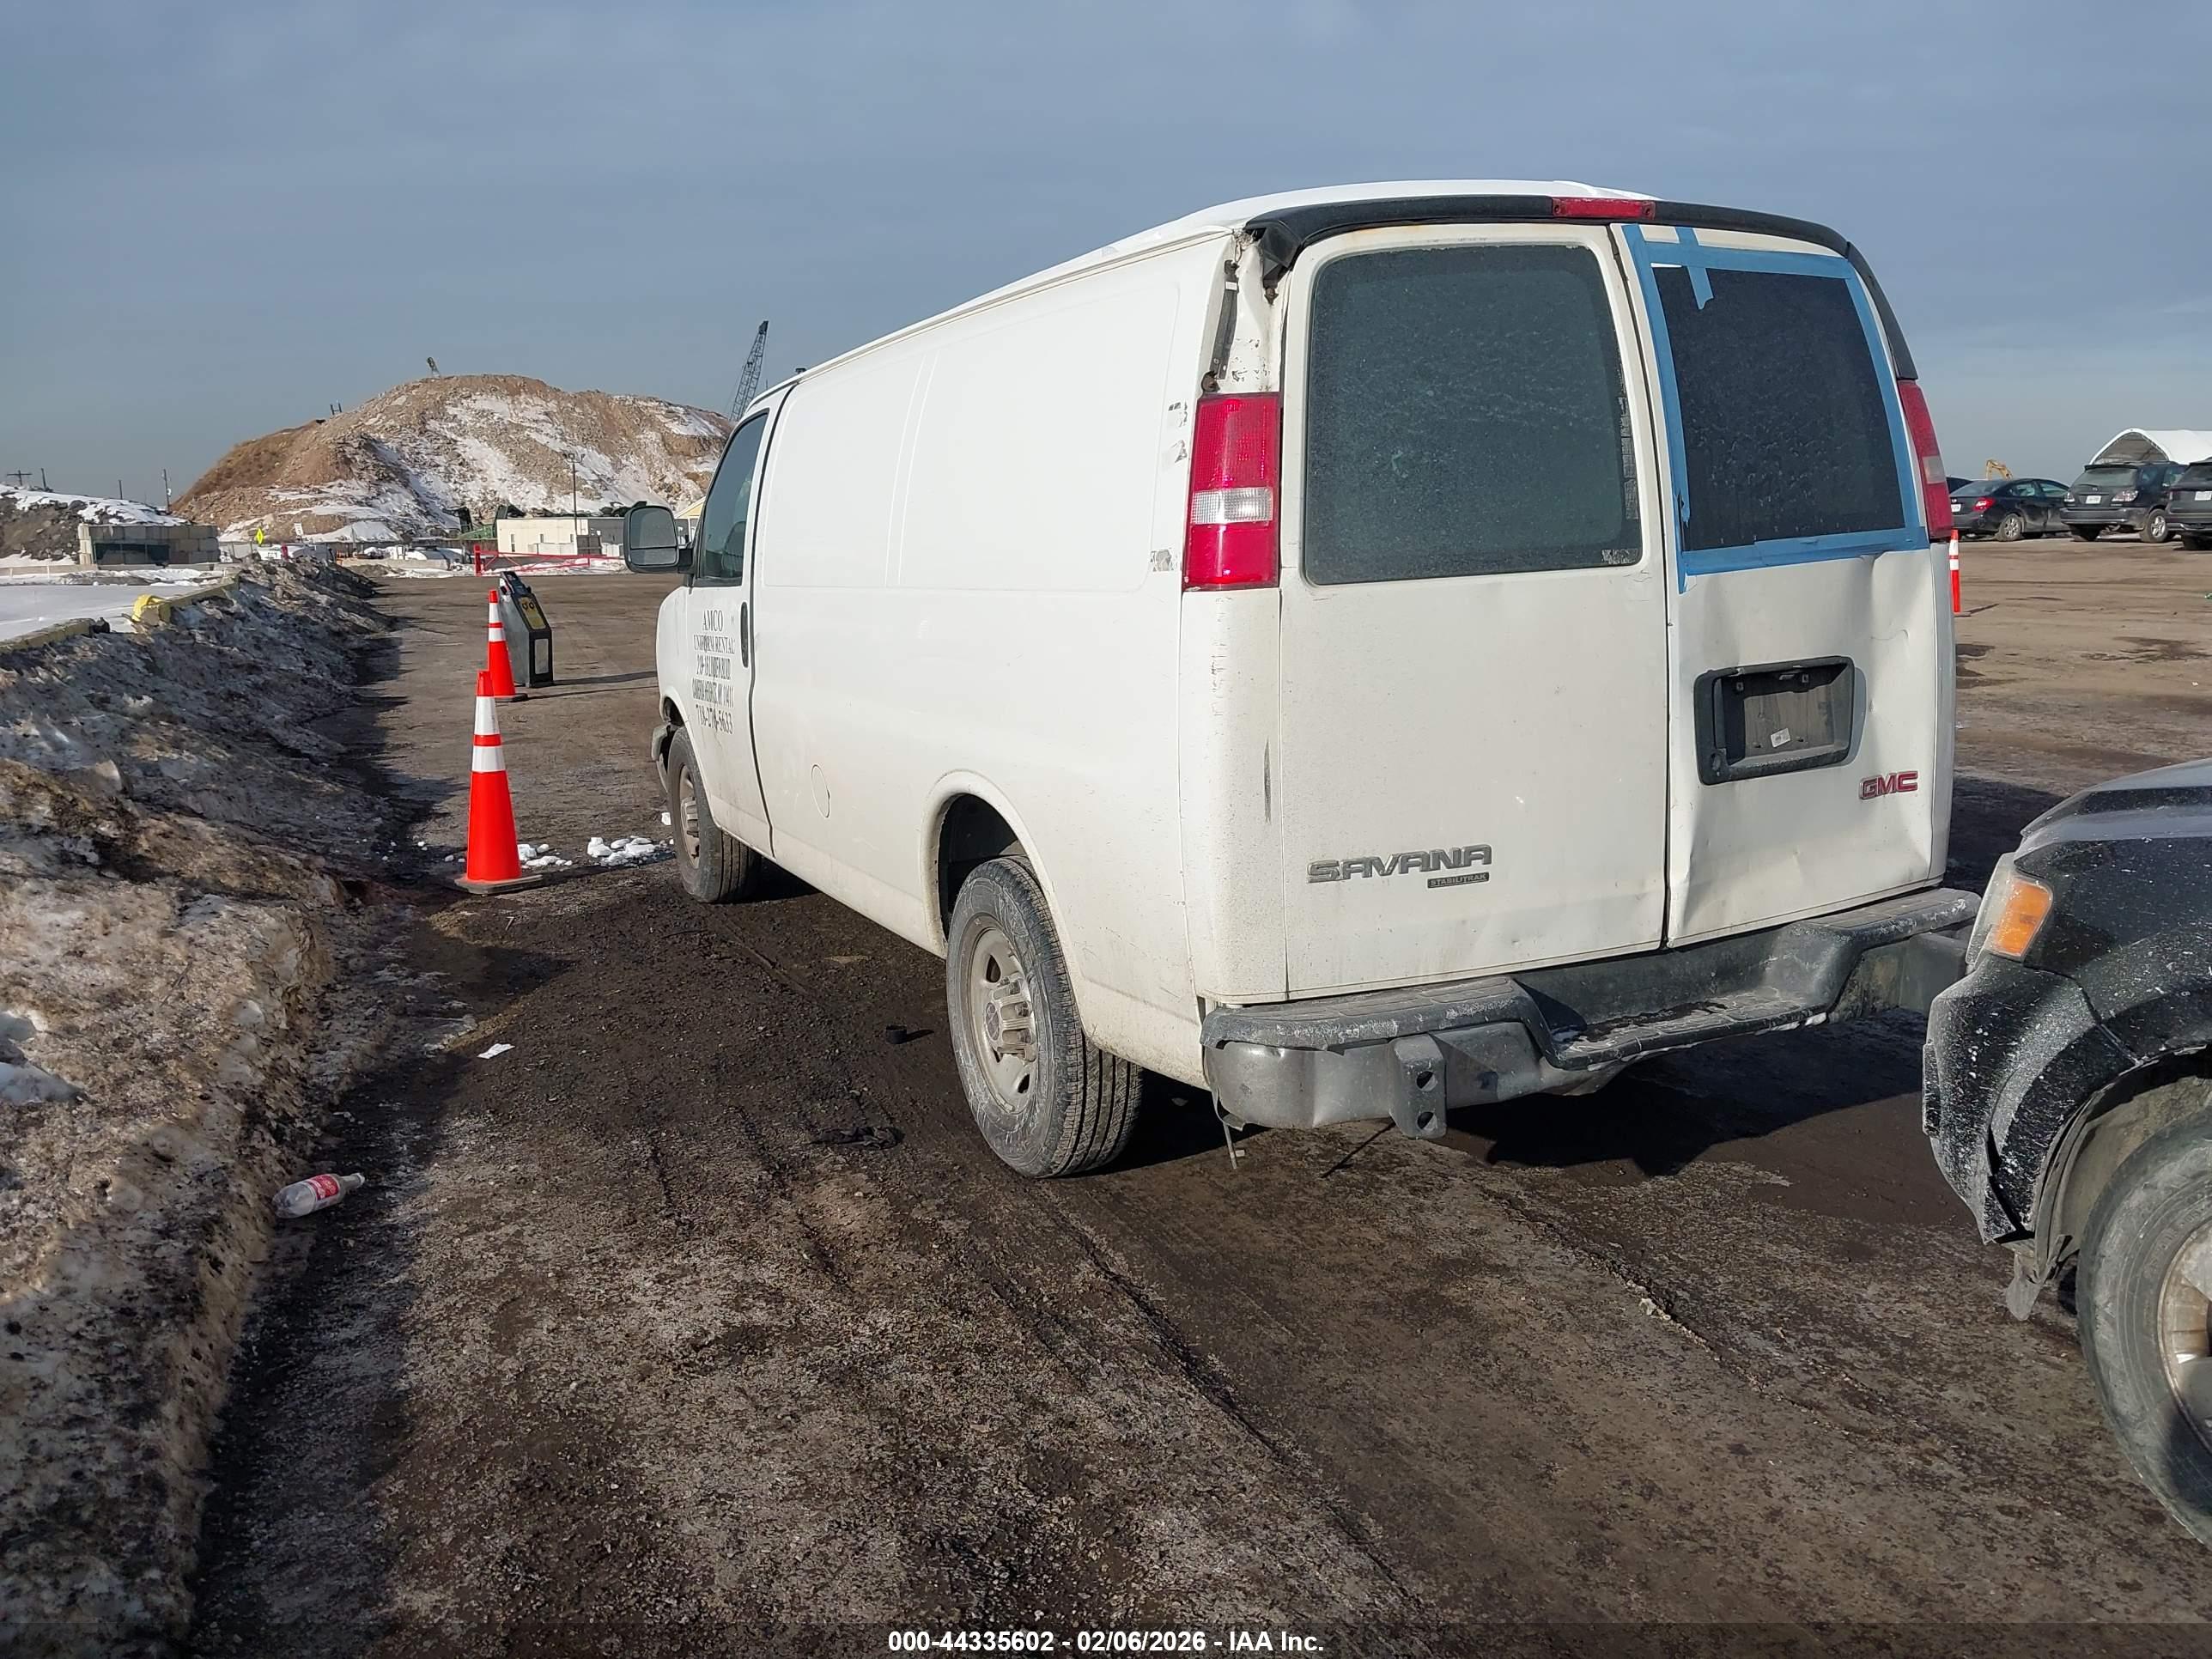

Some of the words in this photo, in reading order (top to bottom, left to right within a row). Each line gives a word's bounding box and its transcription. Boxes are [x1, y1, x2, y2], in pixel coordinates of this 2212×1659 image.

[702, 610, 724, 632] AMCO
[693, 634, 714, 653] UNIFORM
[714, 635, 734, 654] RENTAL
[1859, 770, 1918, 800] GMC
[1307, 843, 1492, 884] SAVANA
[1430, 873, 1489, 888] STABILITRAK
